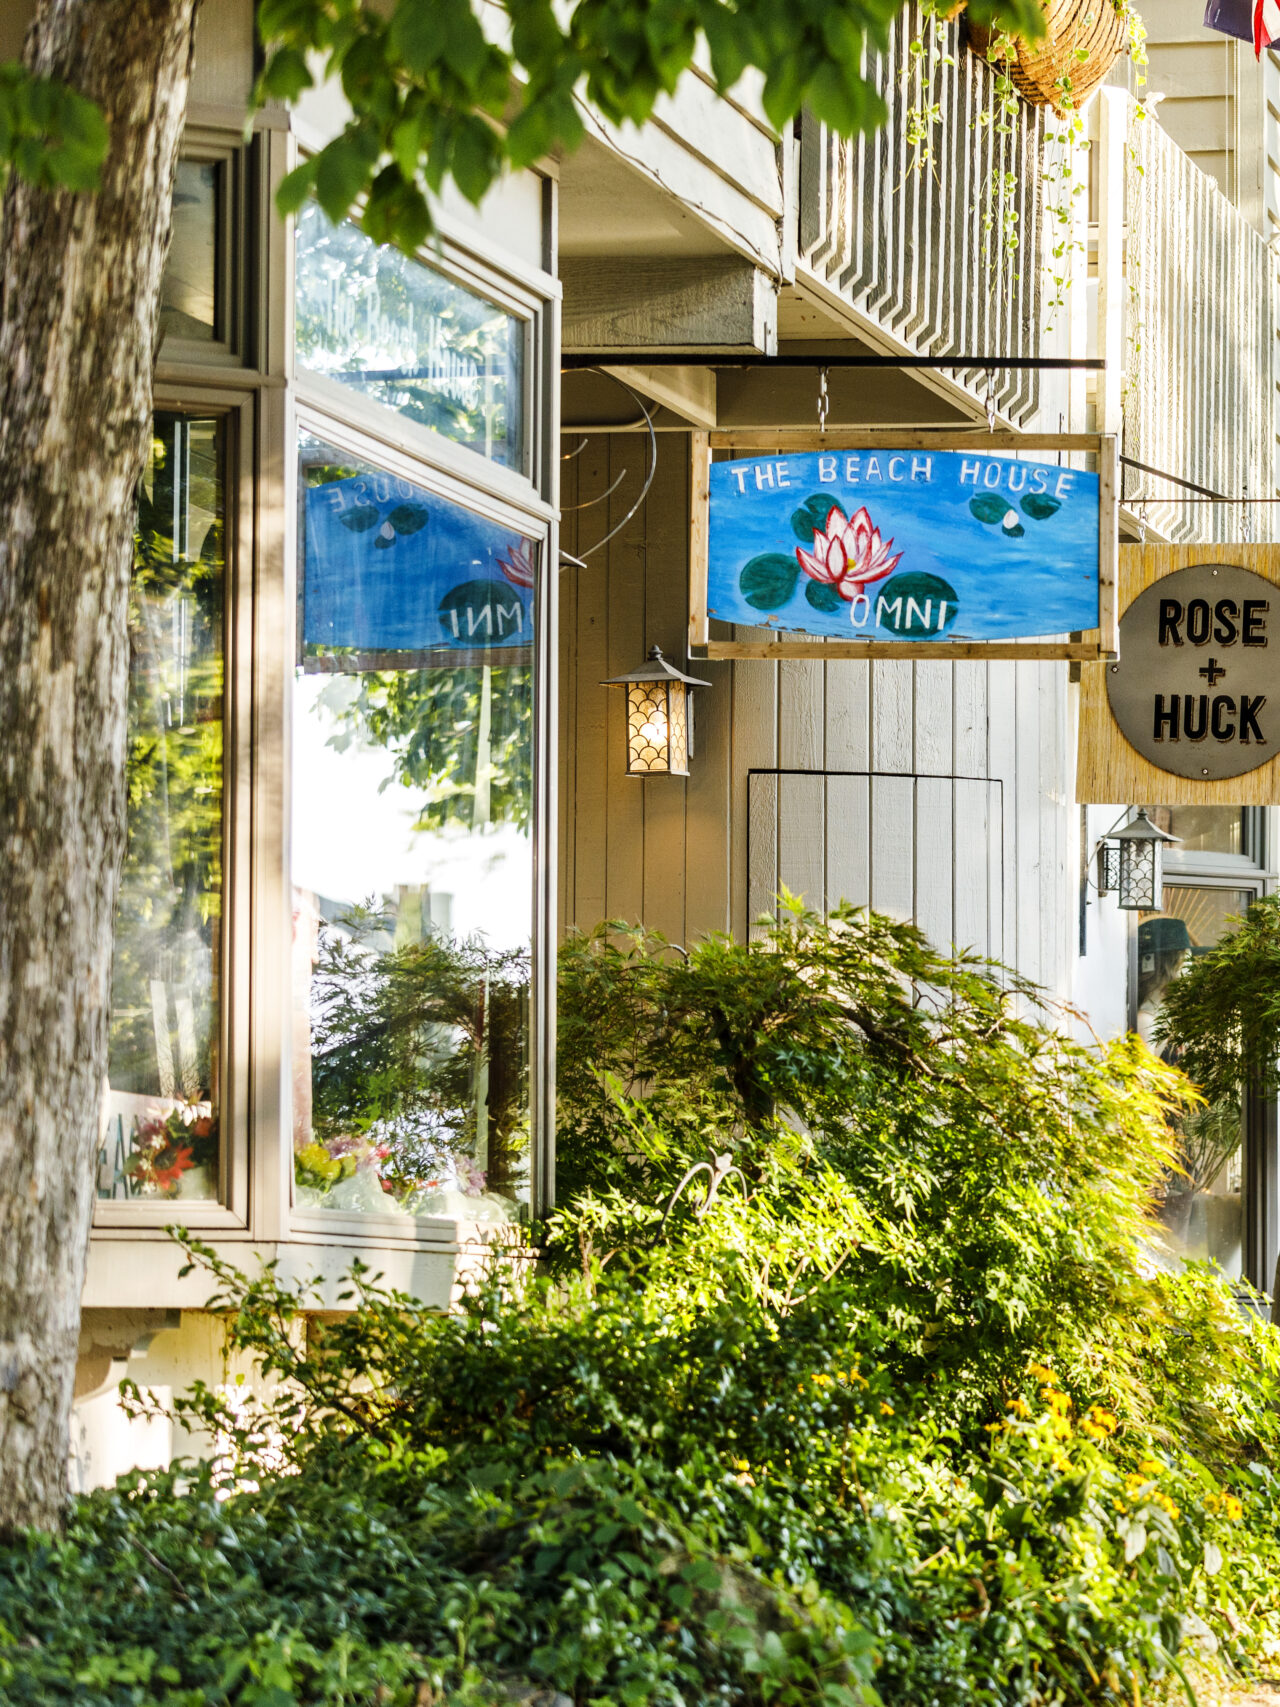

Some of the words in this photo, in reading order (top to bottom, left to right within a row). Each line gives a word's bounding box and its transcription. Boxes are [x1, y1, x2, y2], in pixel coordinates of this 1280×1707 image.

[731, 461, 791, 494] THE
[818, 456, 932, 484] BEACH
[959, 460, 1075, 499] HOUSE
[850, 593, 948, 631] OMNI
[1158, 598, 1270, 648] ROSE
[1199, 658, 1226, 687] +
[1153, 694, 1267, 743] HUCK
